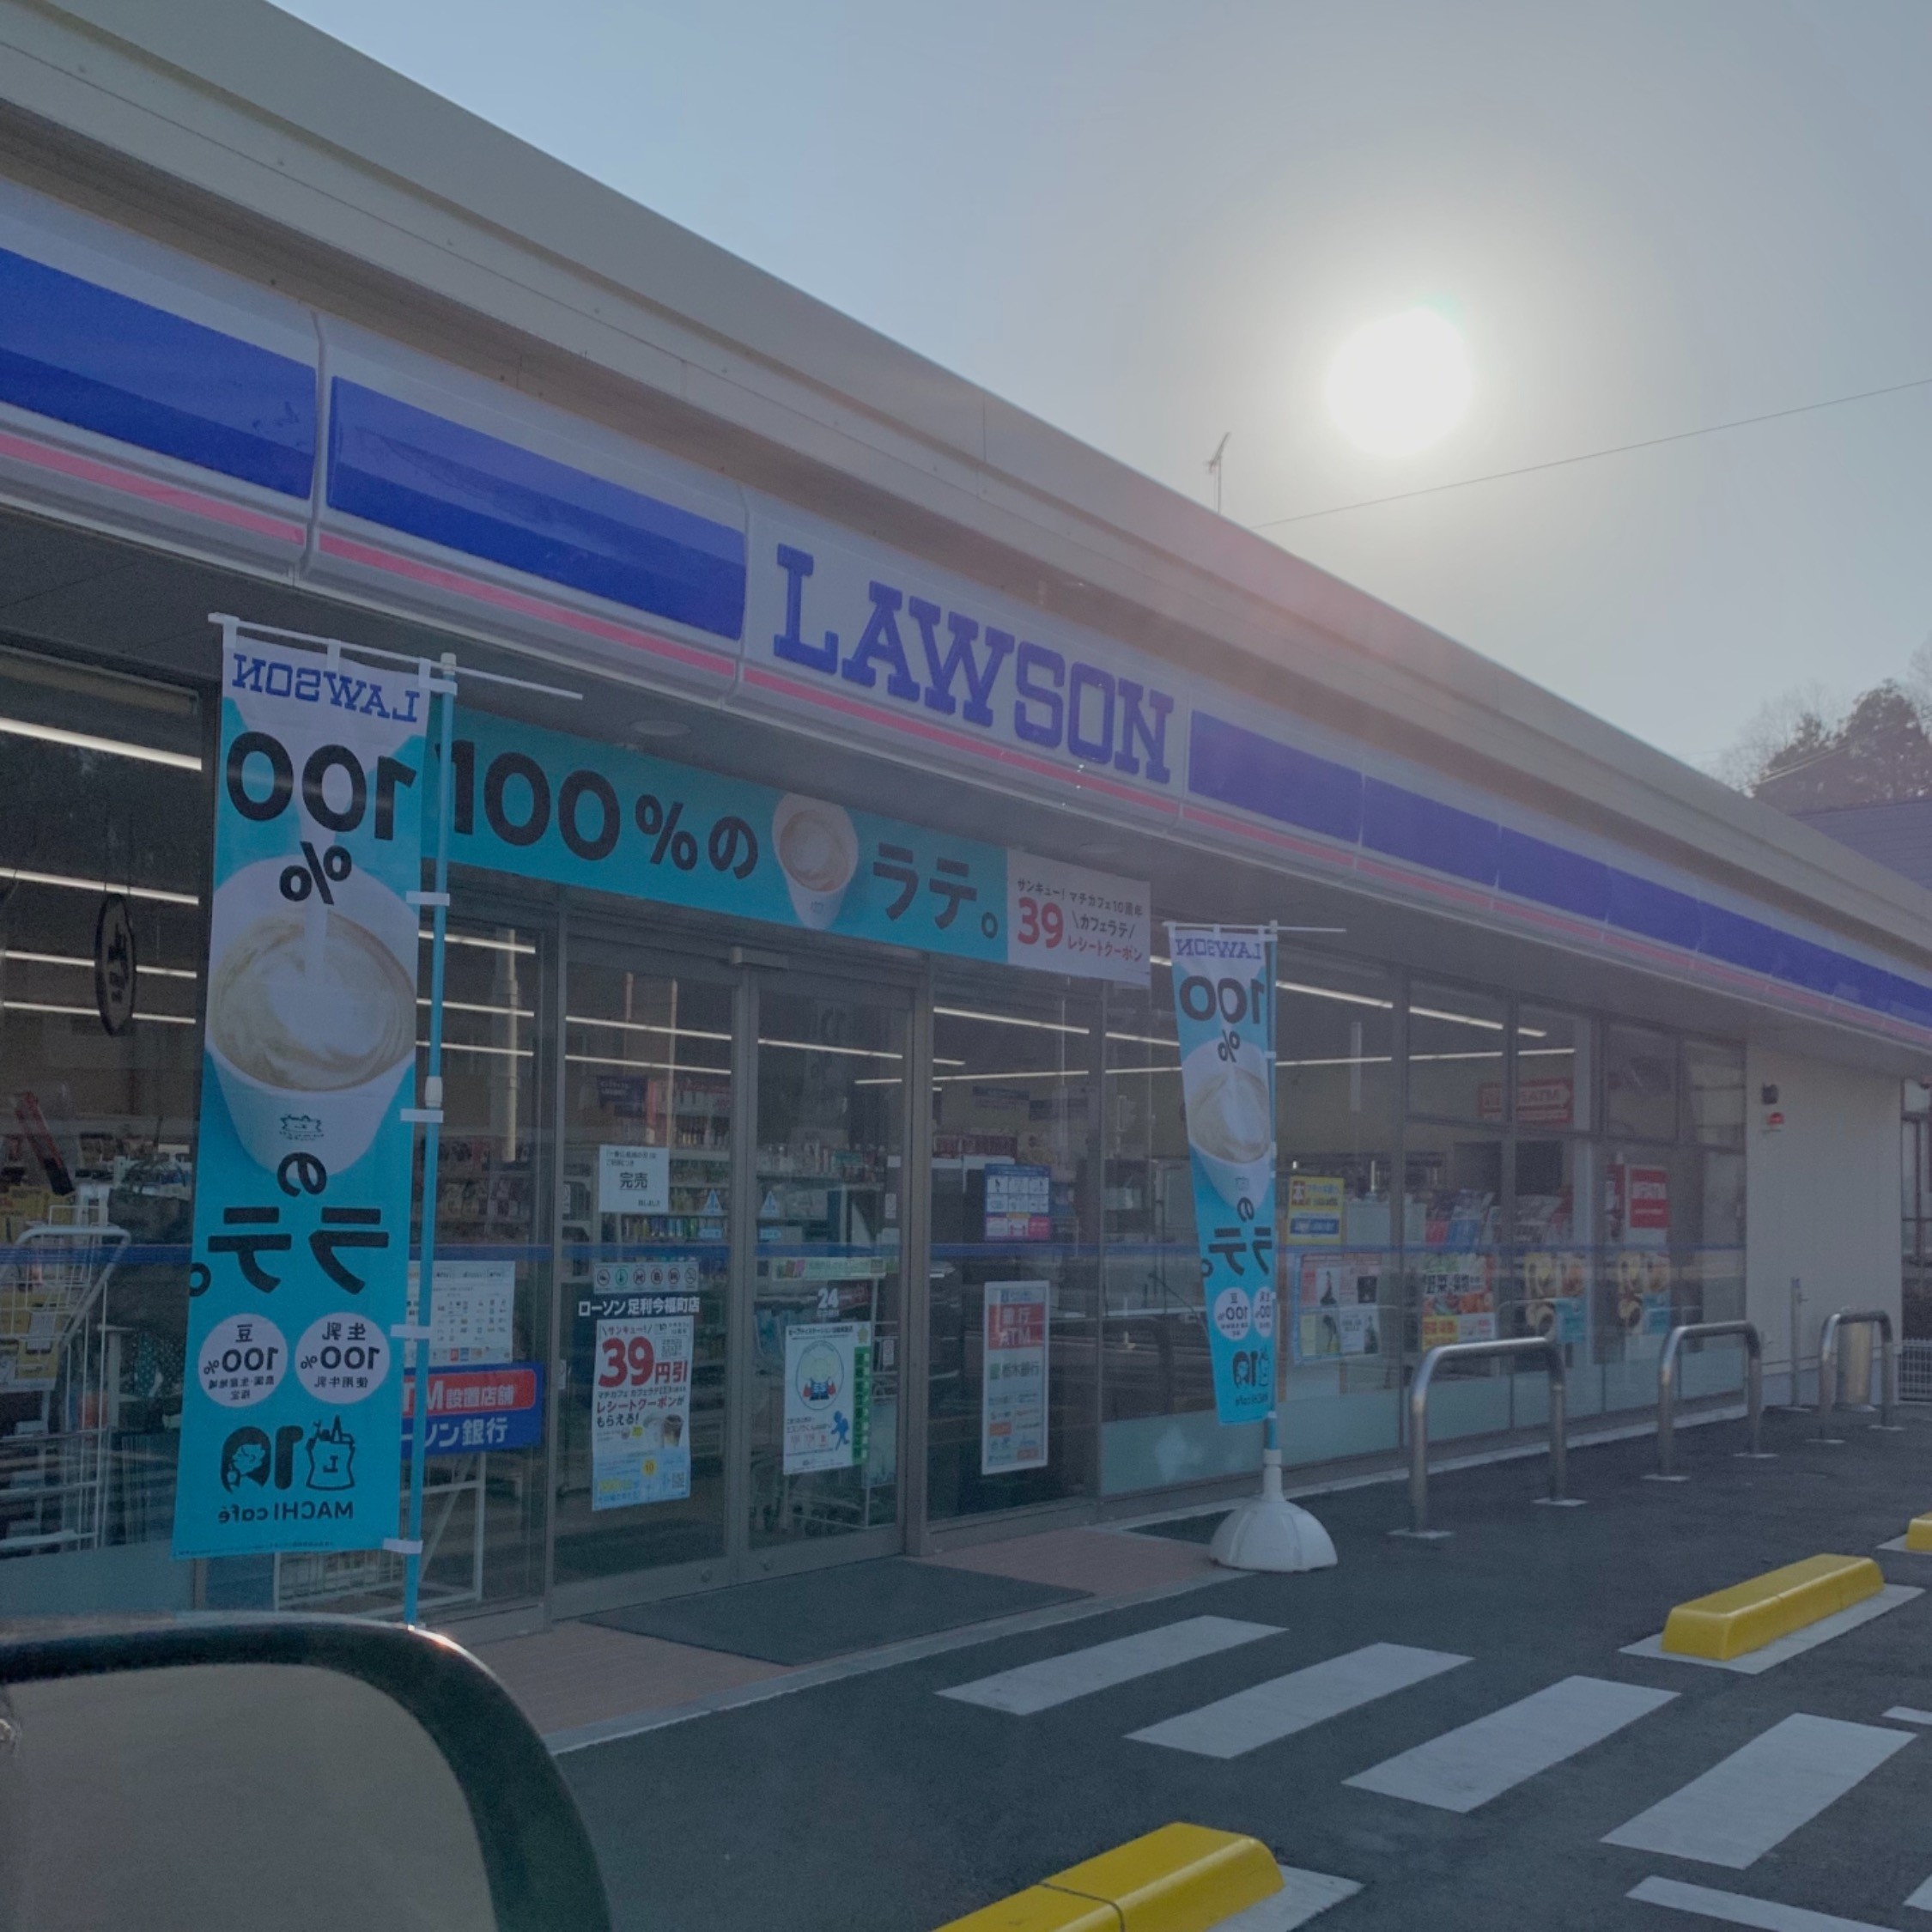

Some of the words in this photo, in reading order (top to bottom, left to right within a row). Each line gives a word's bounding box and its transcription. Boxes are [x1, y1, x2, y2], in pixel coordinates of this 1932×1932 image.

[774, 543, 1174, 785] LAWSON
[1018, 896, 1064, 949] 39
[619, 1171, 648, 1189] 完売
[817, 1288, 840, 1309] 24
